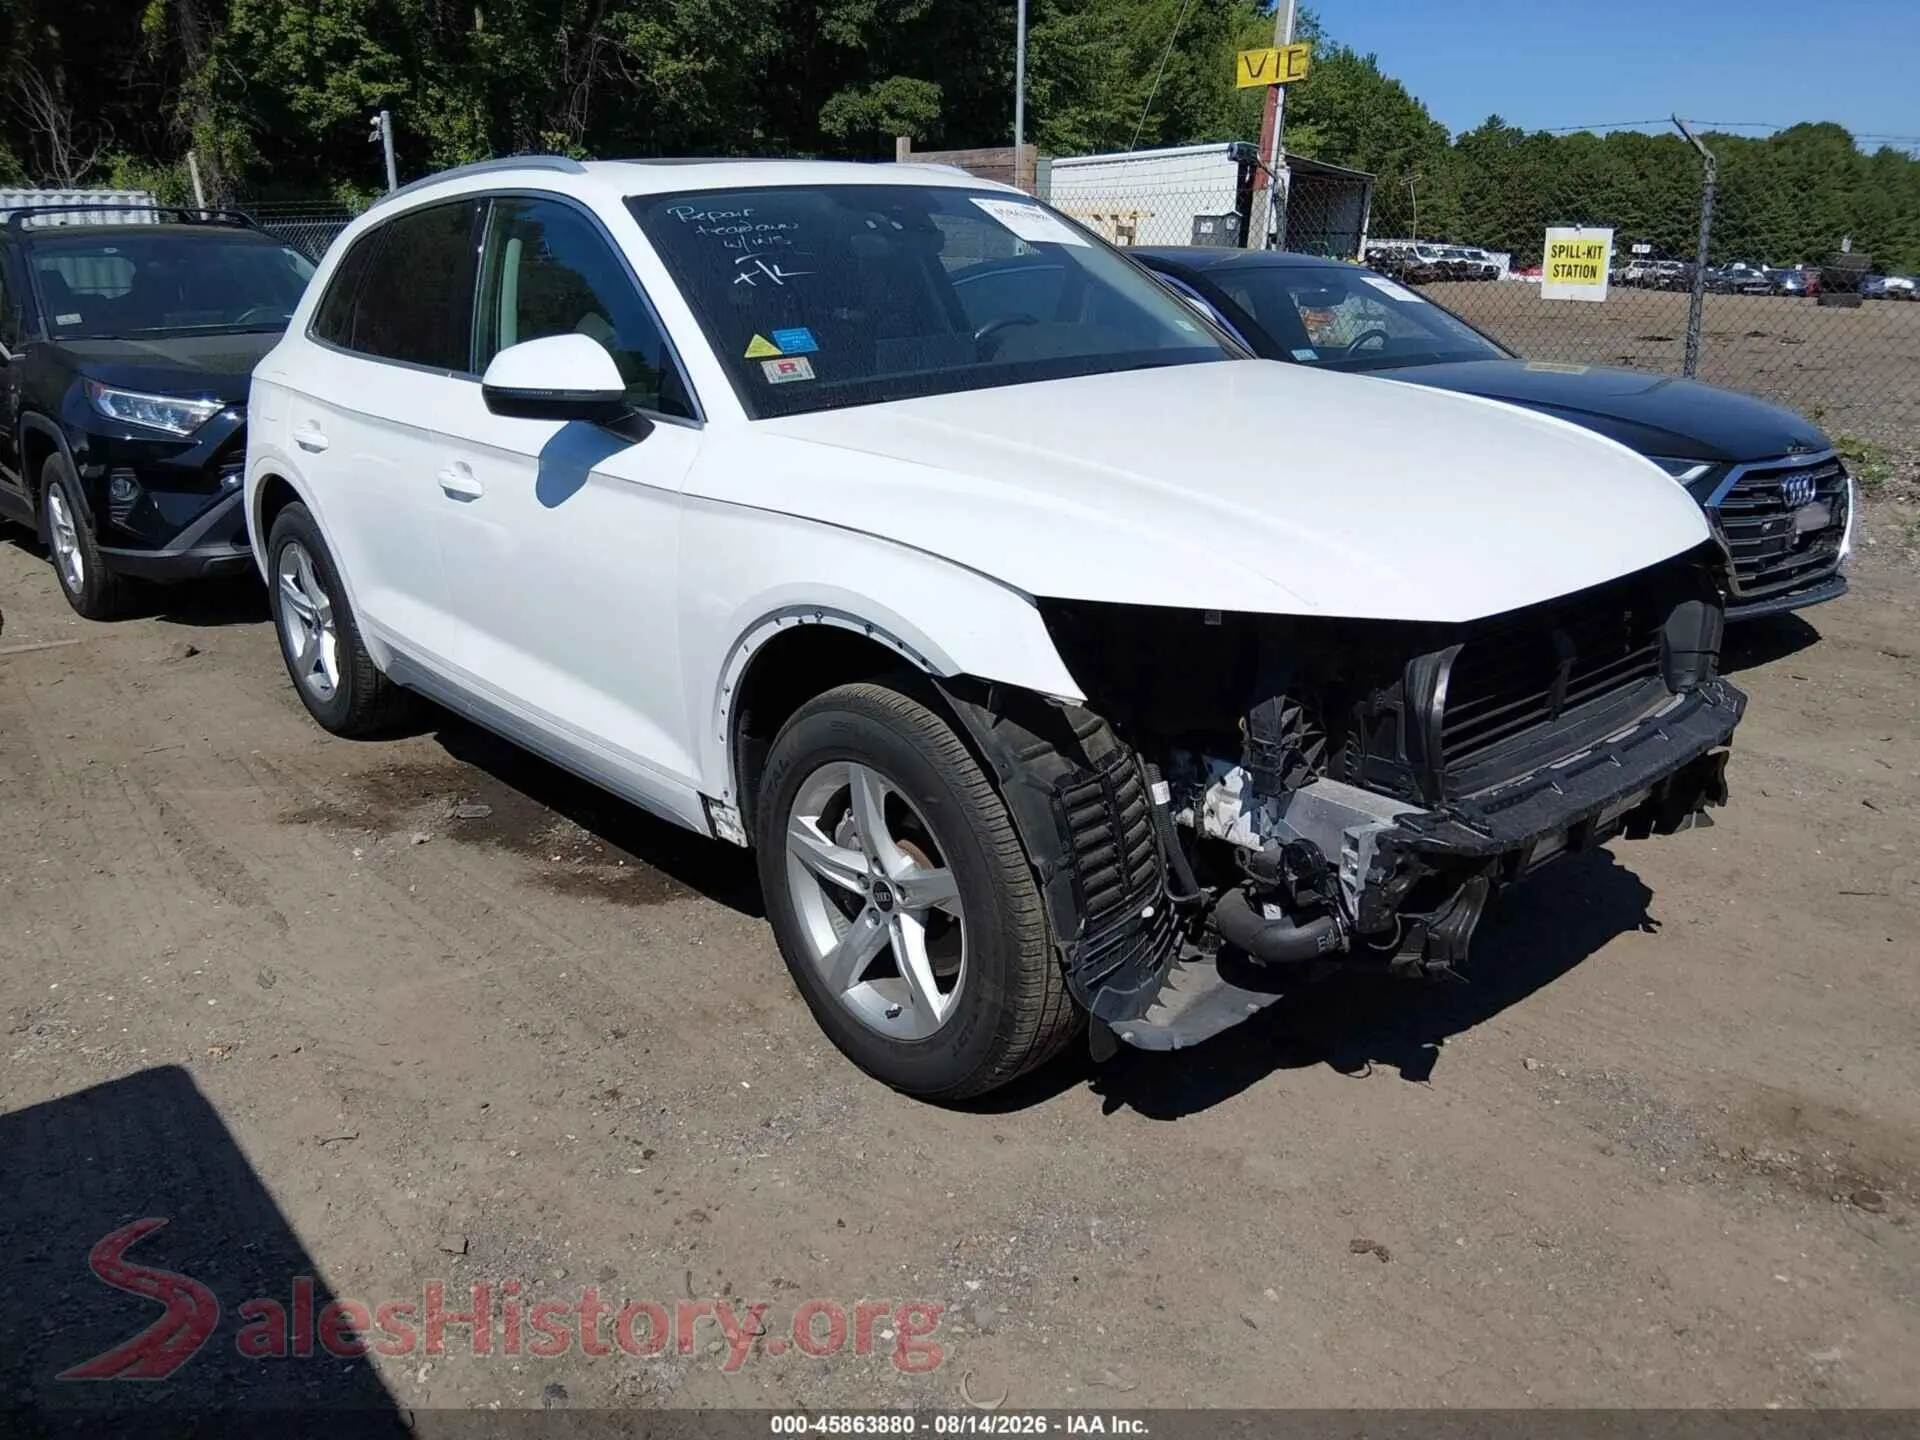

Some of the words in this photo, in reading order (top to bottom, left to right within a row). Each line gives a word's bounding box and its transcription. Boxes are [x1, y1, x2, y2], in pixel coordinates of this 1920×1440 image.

[667, 206, 754, 223] Repair
[1551, 244, 1603, 259] SPILL-KIT
[1553, 263, 1598, 279] STATION
